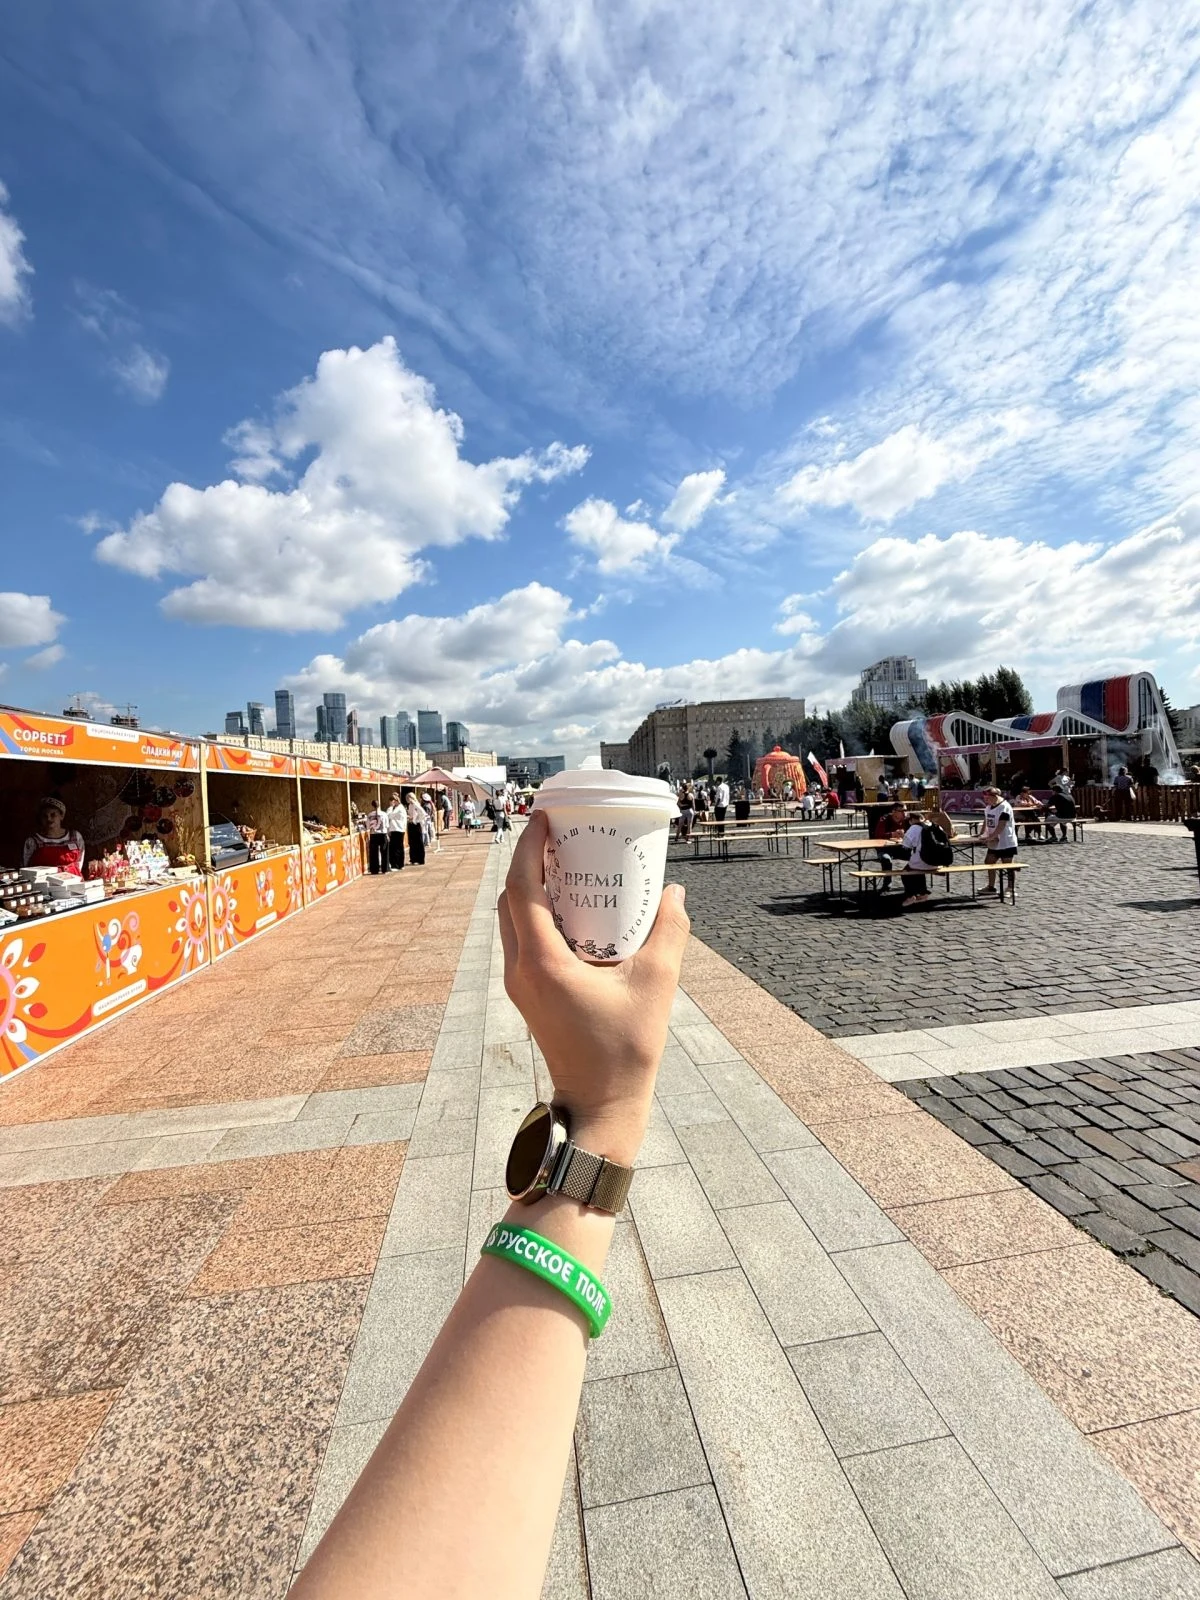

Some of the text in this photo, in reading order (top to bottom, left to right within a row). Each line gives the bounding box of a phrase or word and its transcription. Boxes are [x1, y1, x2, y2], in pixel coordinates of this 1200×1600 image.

[13, 728, 67, 745] СОРБЕТТ
[20, 746, 40, 754] ГОРОД
[555, 827, 579, 847] НАШ
[564, 872, 623, 887] ВРЕМЯ
[569, 893, 617, 908] ЧАГИ
[497, 1230, 606, 1317] РУССКОЕ ПОЛЕ
